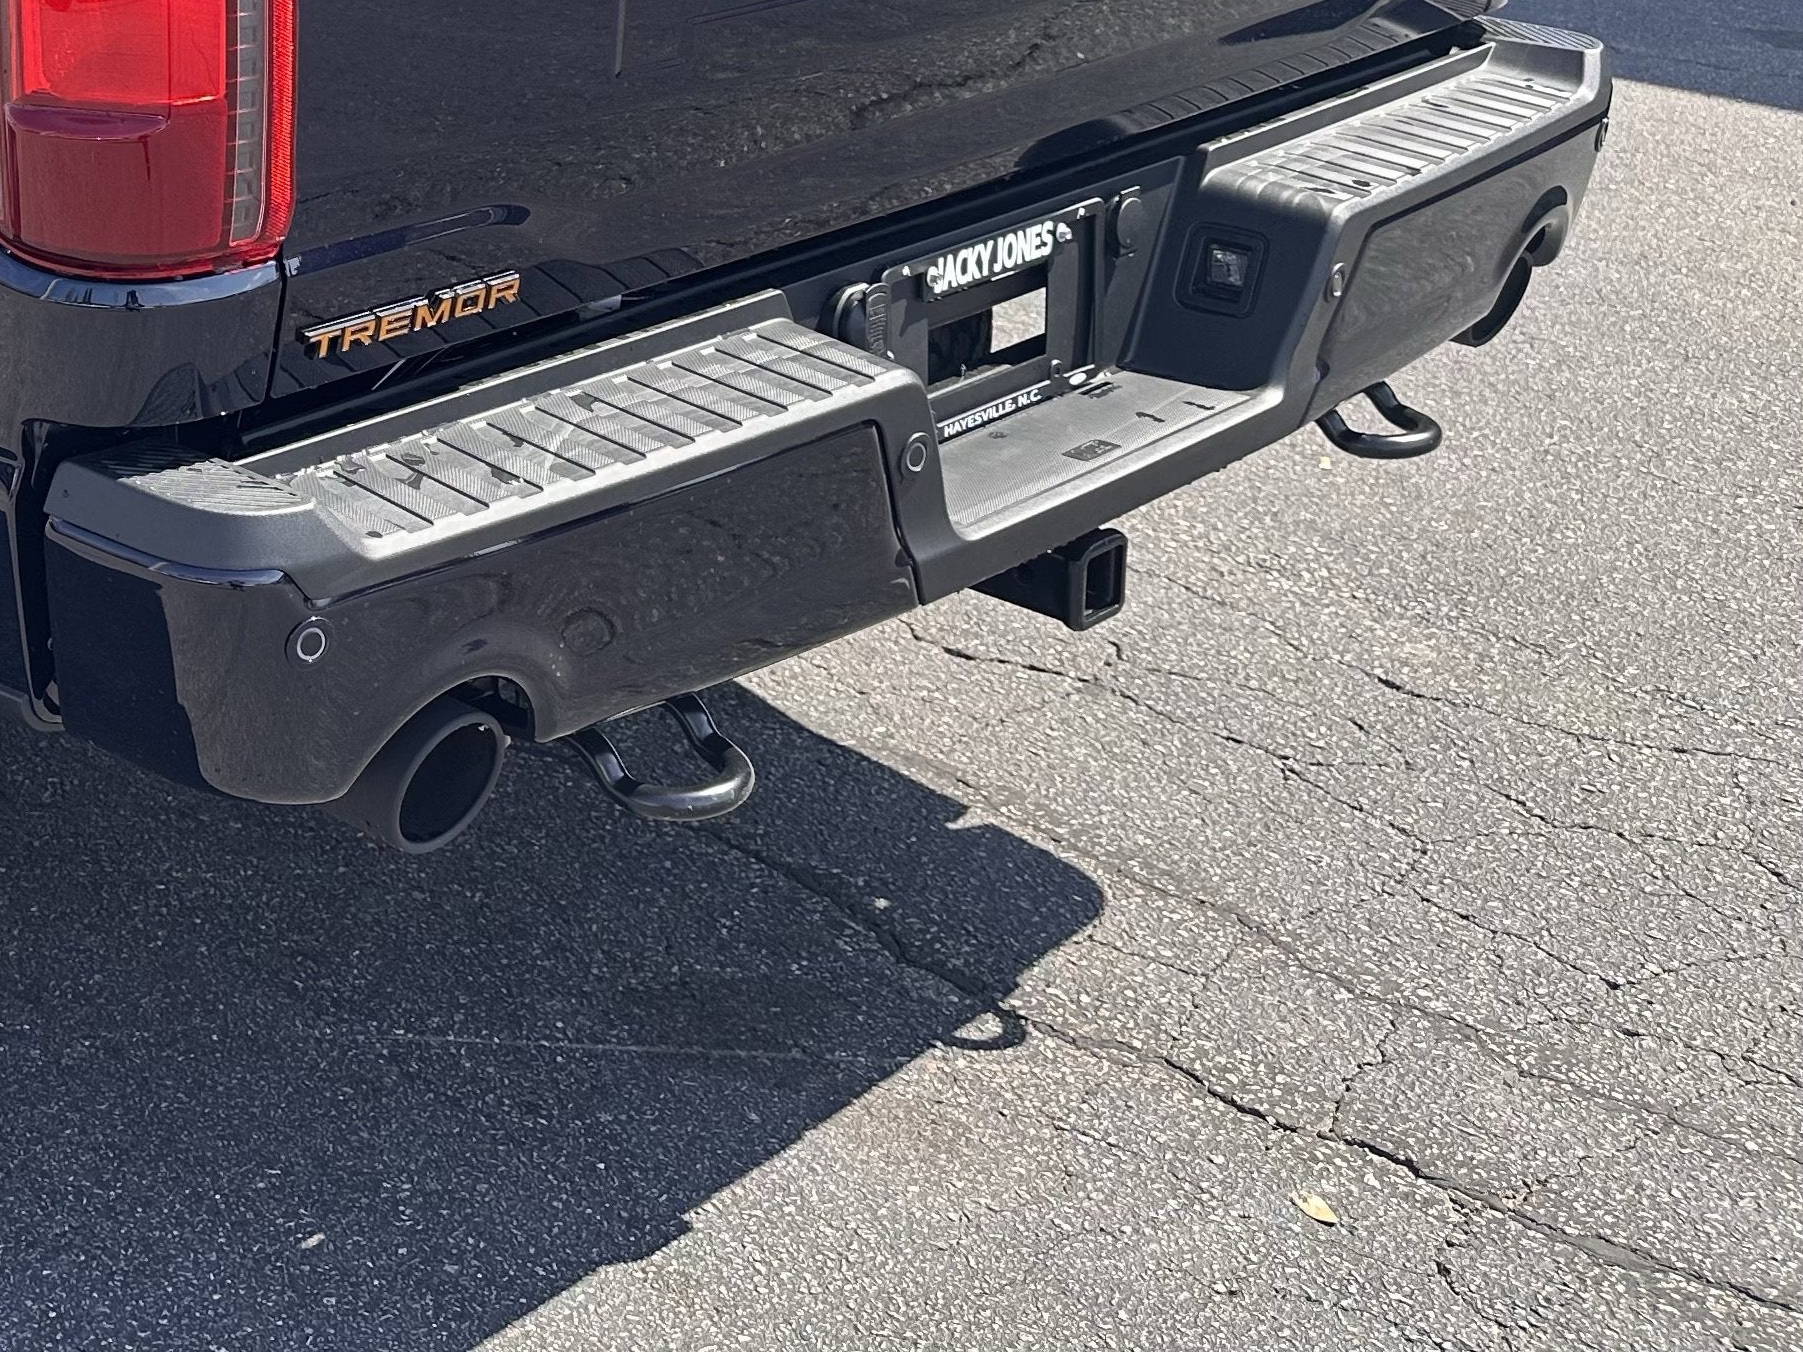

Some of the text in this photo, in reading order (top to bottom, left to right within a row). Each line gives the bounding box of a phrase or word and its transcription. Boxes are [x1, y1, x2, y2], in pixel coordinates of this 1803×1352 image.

[928, 220, 1054, 294] JACKY JONES
[297, 270, 521, 359] TREMOR
[1017, 389, 1043, 408] N.C.
